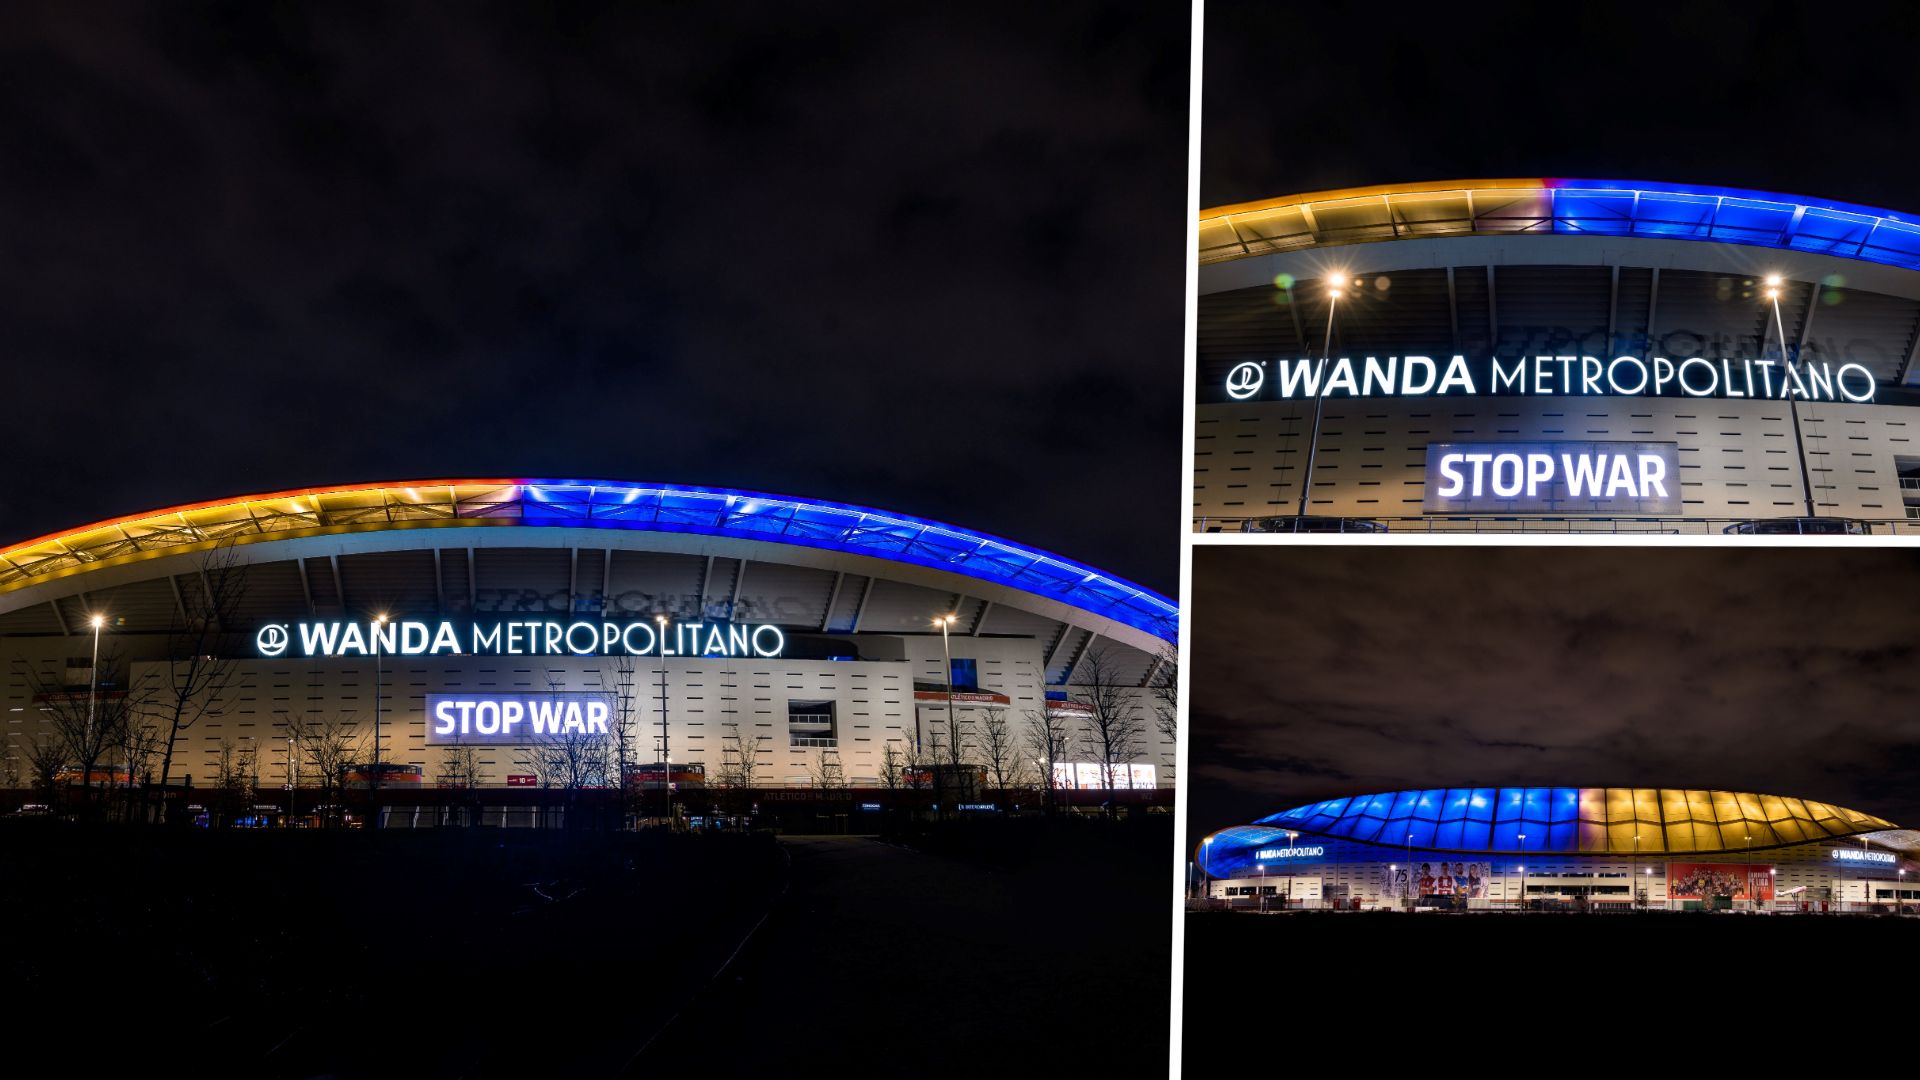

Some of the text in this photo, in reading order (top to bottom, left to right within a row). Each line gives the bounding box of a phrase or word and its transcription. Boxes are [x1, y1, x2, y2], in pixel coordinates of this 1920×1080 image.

[1279, 355, 1876, 402] WANDA METROPOLITANO
[1438, 453, 1669, 497] STOP WAR
[299, 621, 784, 657] WANDA METROPOLITANO
[435, 701, 609, 735] STOP WAR
